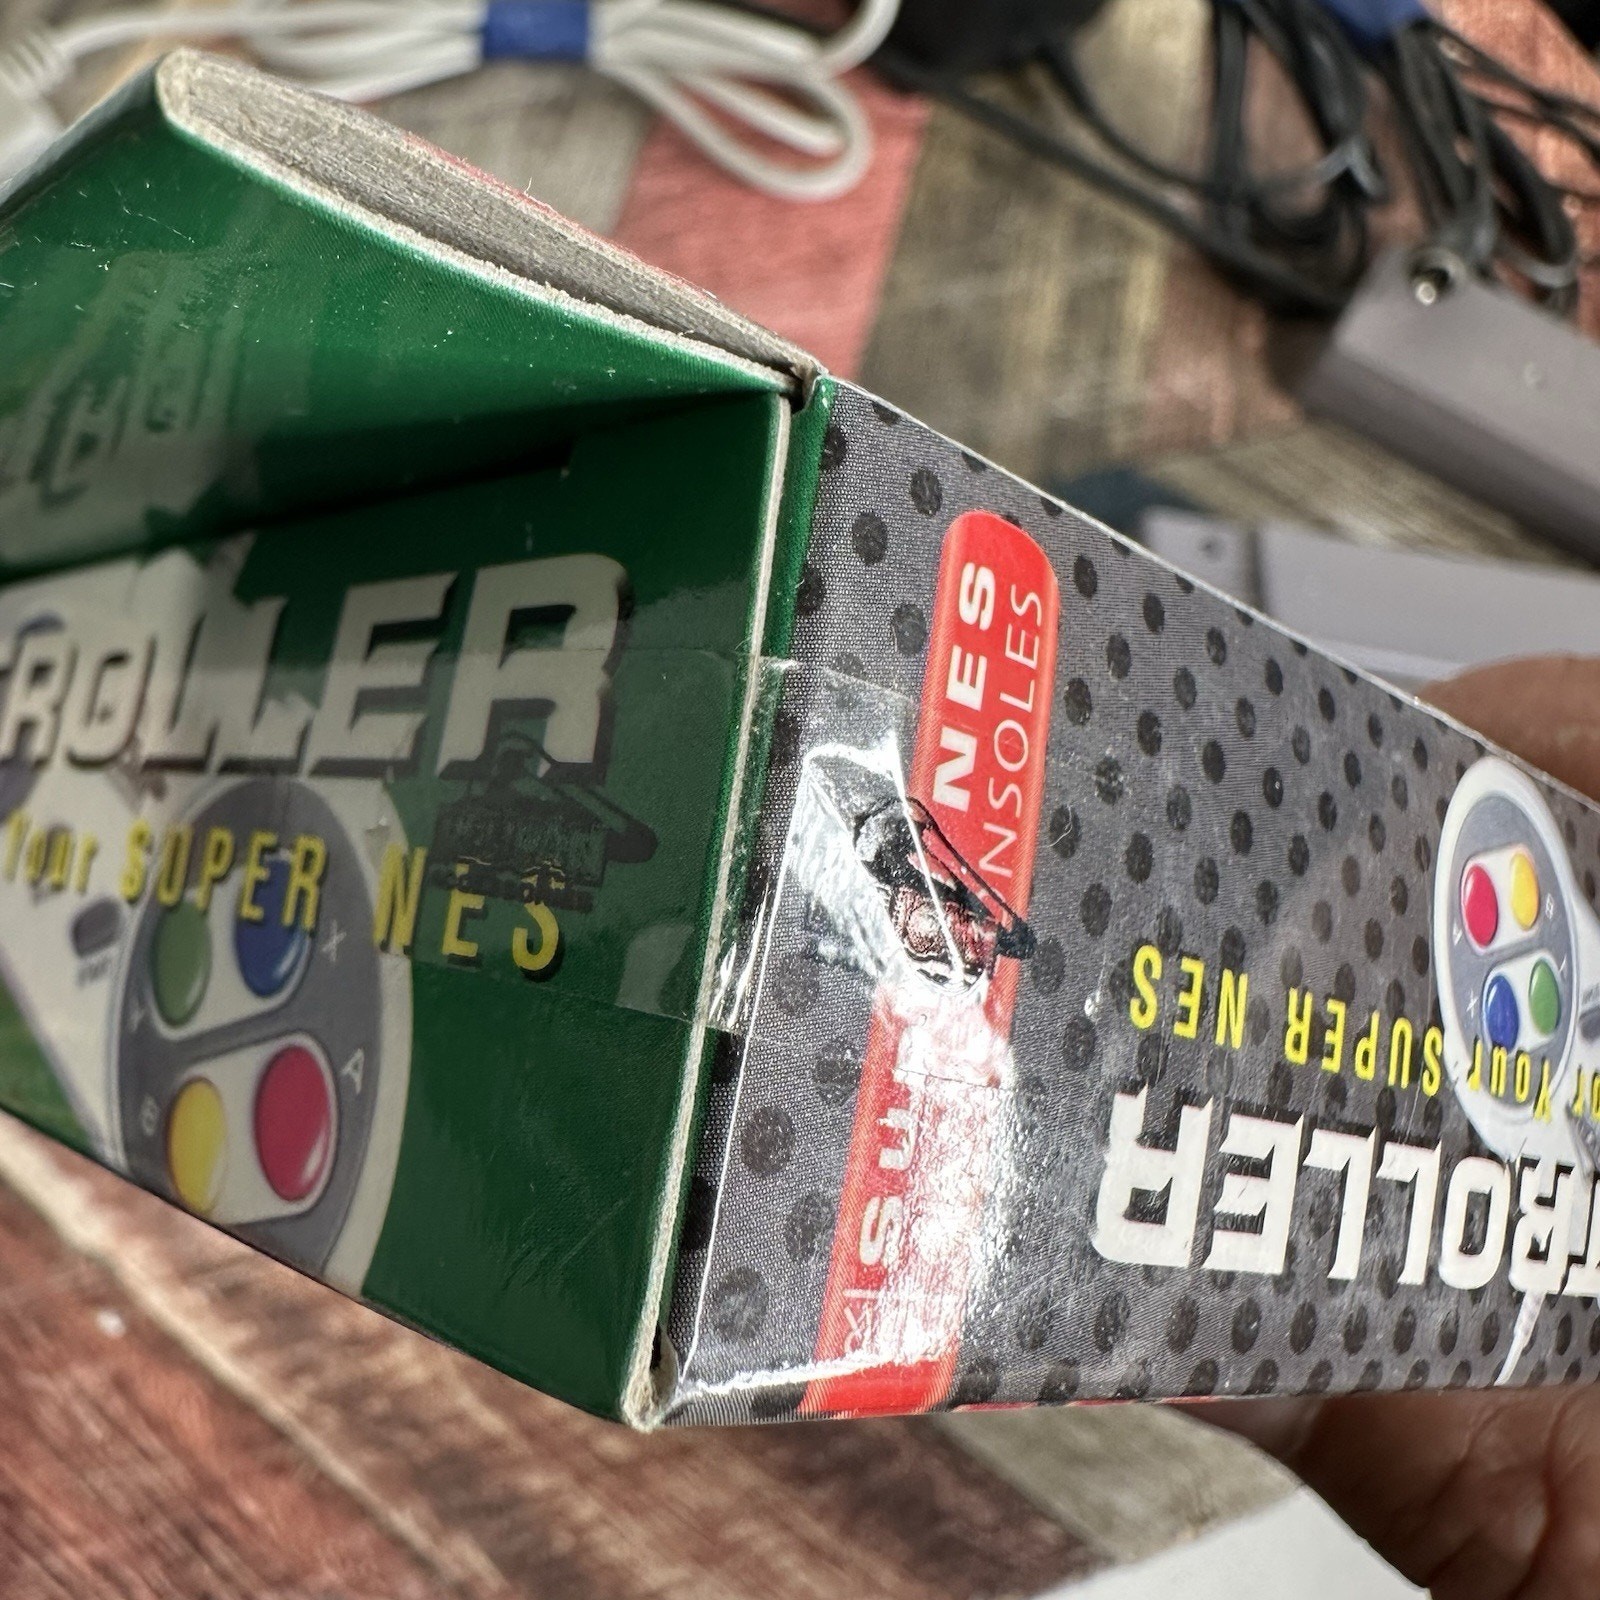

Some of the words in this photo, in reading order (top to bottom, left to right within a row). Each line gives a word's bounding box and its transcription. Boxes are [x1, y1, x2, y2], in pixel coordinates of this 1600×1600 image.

[0, 553, 630, 778] ROLLER
[931, 561, 997, 812] NES
[120, 819, 328, 931] SUPER
[373, 843, 563, 971] NES
[1129, 944, 1248, 1049] NES
[1283, 987, 1444, 1097] SUPER
[341, 1047, 365, 1095] A
[1466, 1036, 1551, 1122] Your
